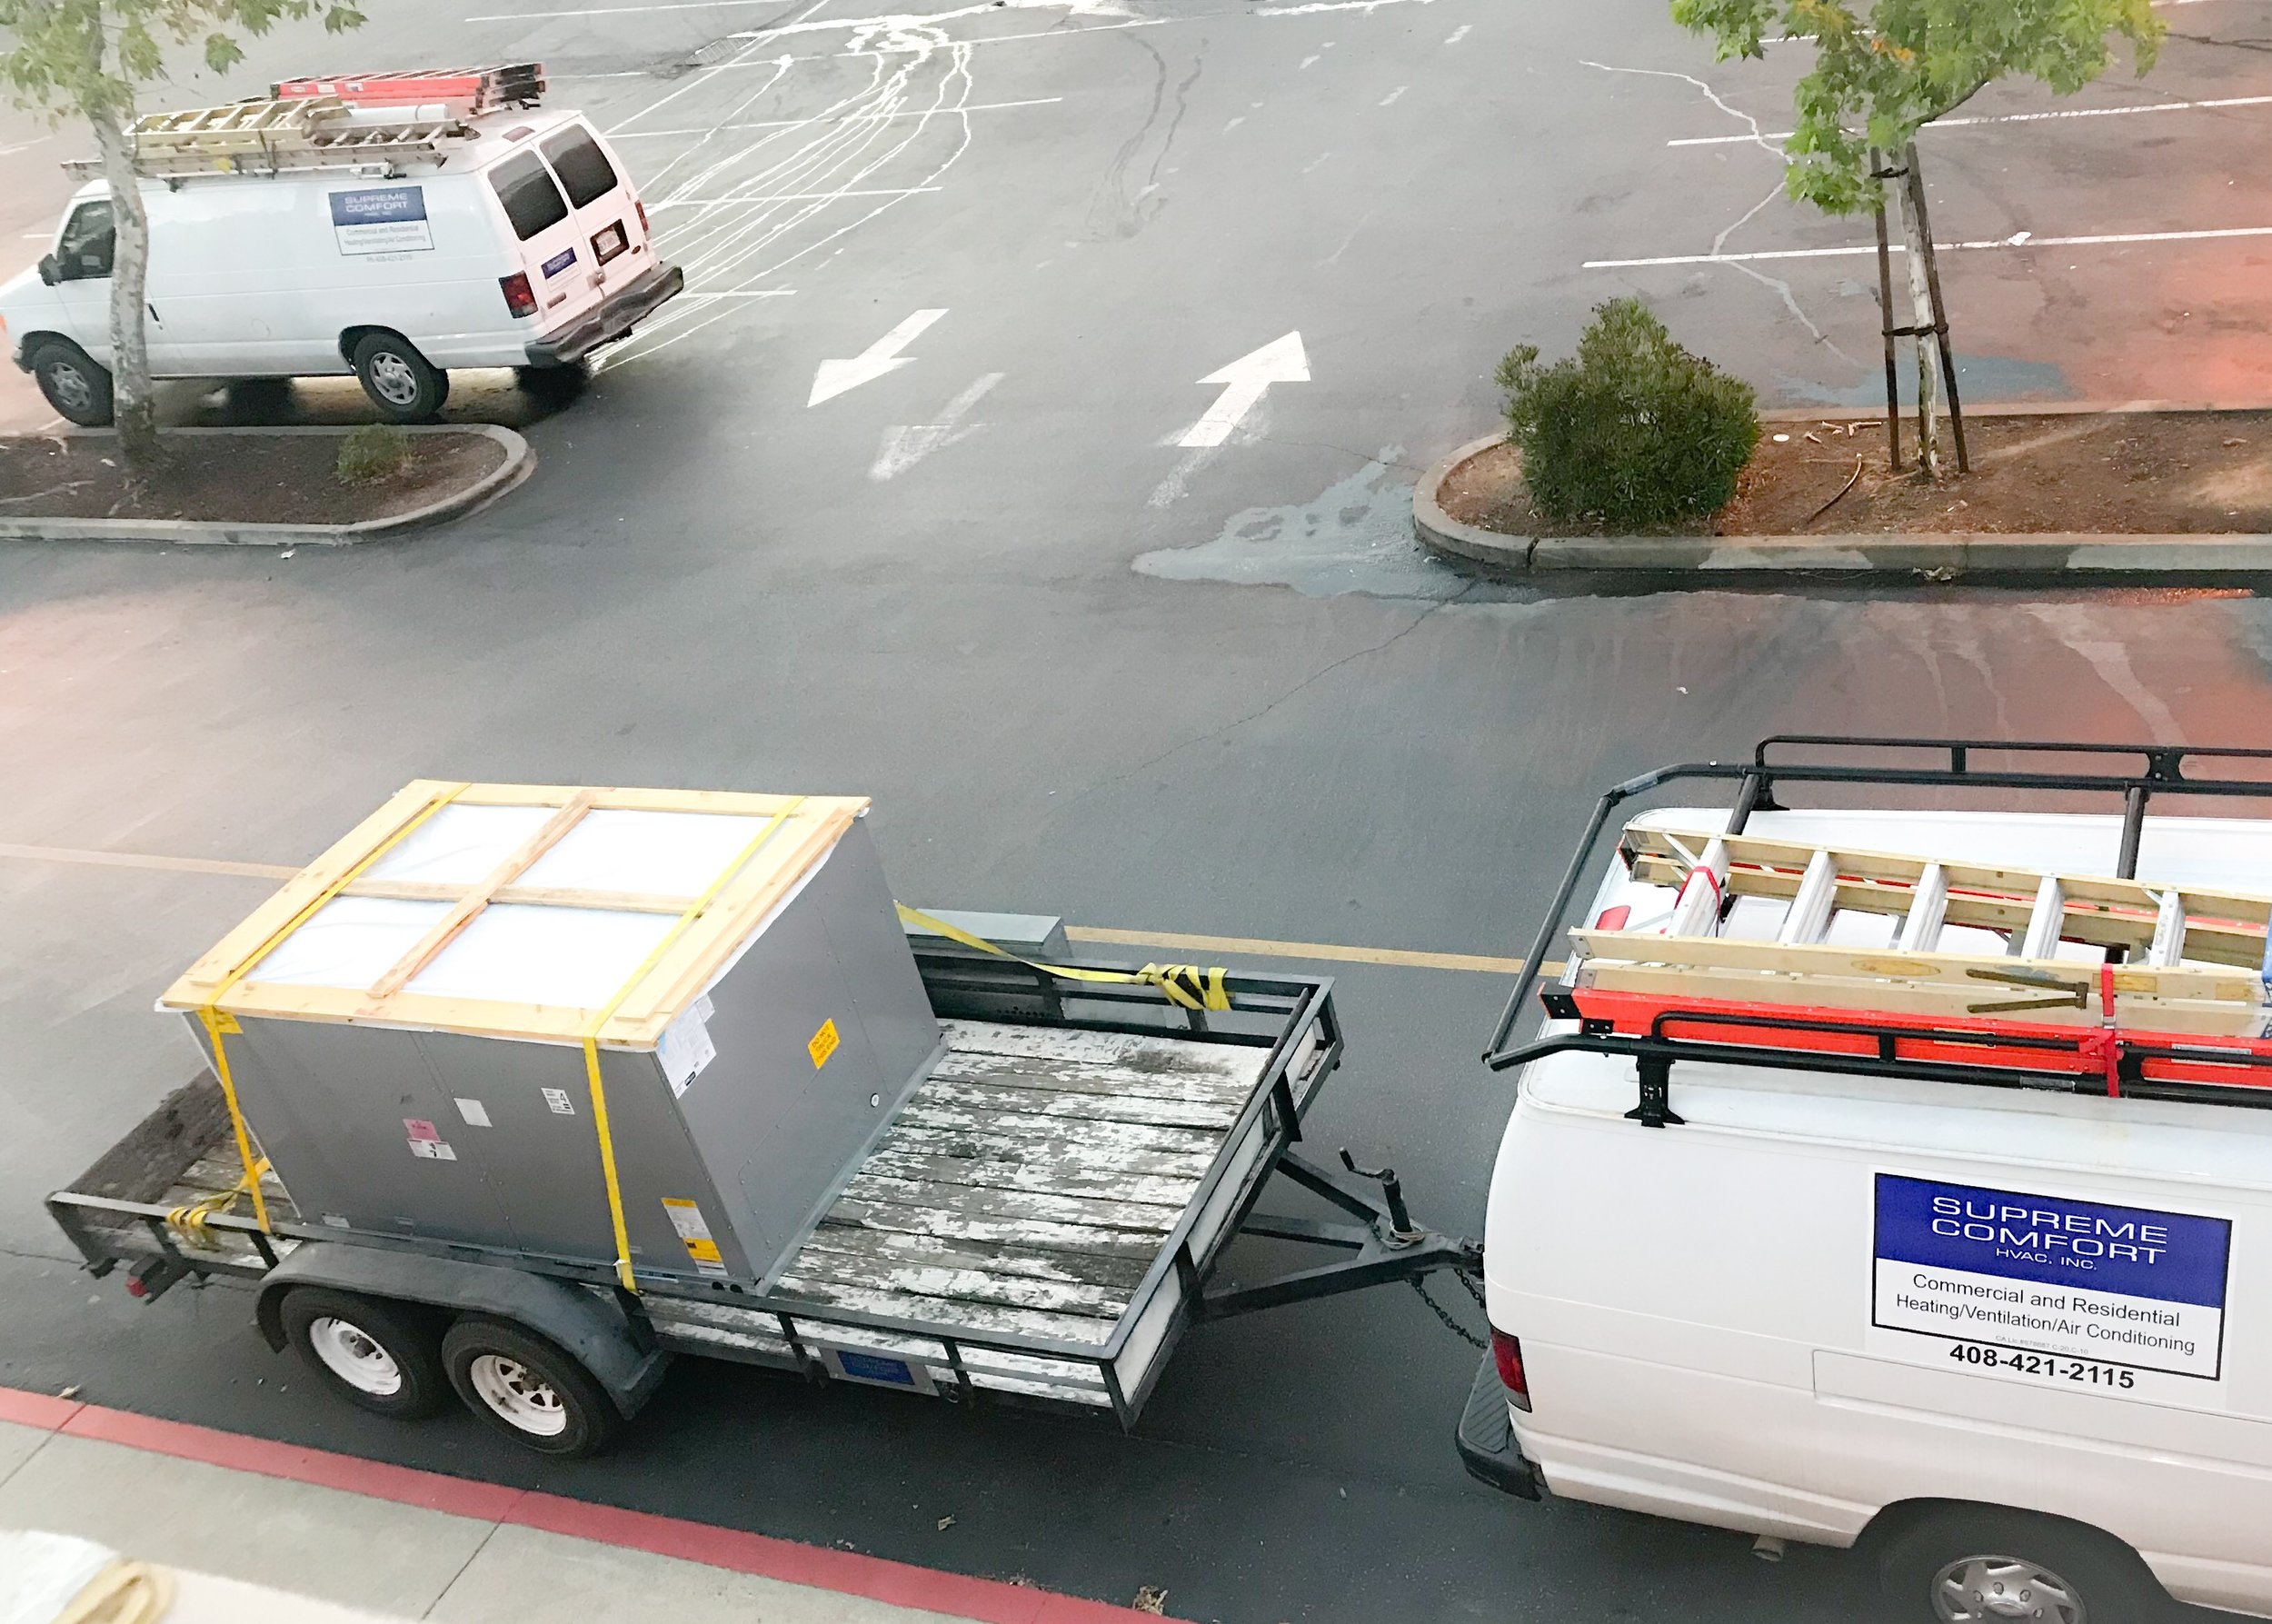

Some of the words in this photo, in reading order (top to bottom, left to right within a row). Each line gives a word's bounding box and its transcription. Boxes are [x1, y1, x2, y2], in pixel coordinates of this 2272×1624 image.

[344, 193, 408, 204] SUPREME
[345, 201, 408, 213] COMFORT
[1931, 1218, 2167, 1264] COMFORT
[1932, 1196, 2168, 1244] SUPREME
[2060, 1257, 2098, 1270] INC.
[1913, 1273, 2024, 1304] Commercial
[2030, 1294, 2065, 1310] and
[2072, 1297, 2180, 1327] Residential
[1897, 1293, 2081, 1335] Heating/Ventilation/Air
[2087, 1323, 2196, 1356] Conditioning
[1949, 1343, 2135, 1389] 408-421-2115
